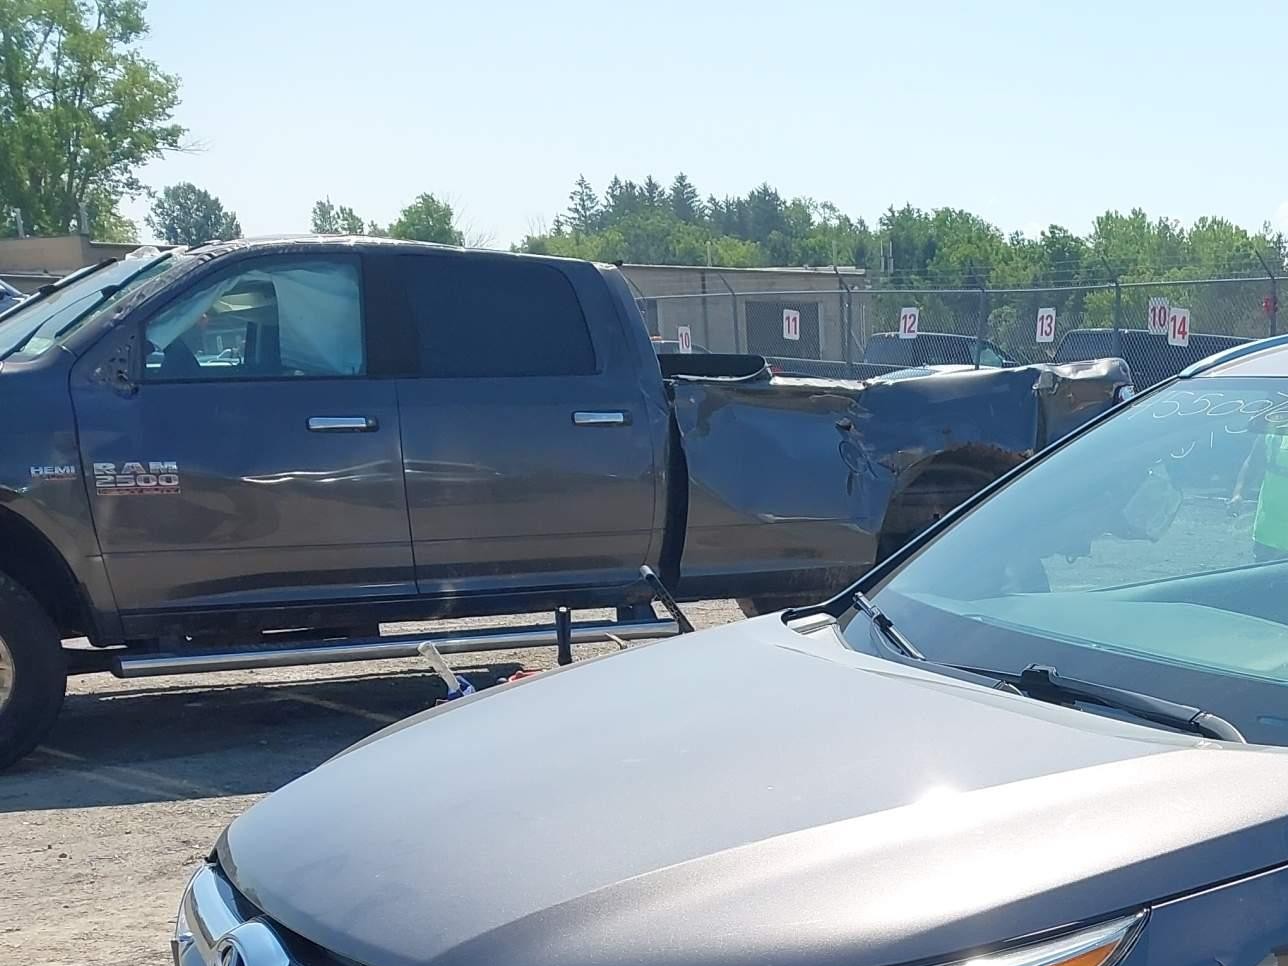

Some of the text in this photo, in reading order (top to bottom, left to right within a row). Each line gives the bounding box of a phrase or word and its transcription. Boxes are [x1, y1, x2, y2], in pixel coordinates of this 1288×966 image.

[784, 315, 798, 335] 11
[901, 313, 916, 334] 12
[1038, 314, 1054, 337] 13
[1150, 306, 1168, 328] 10
[1170, 315, 1188, 340] 14
[680, 332, 690, 349] 10
[30, 464, 76, 476] HEMI
[93, 461, 179, 475] RAM
[95, 474, 180, 487] 2500
